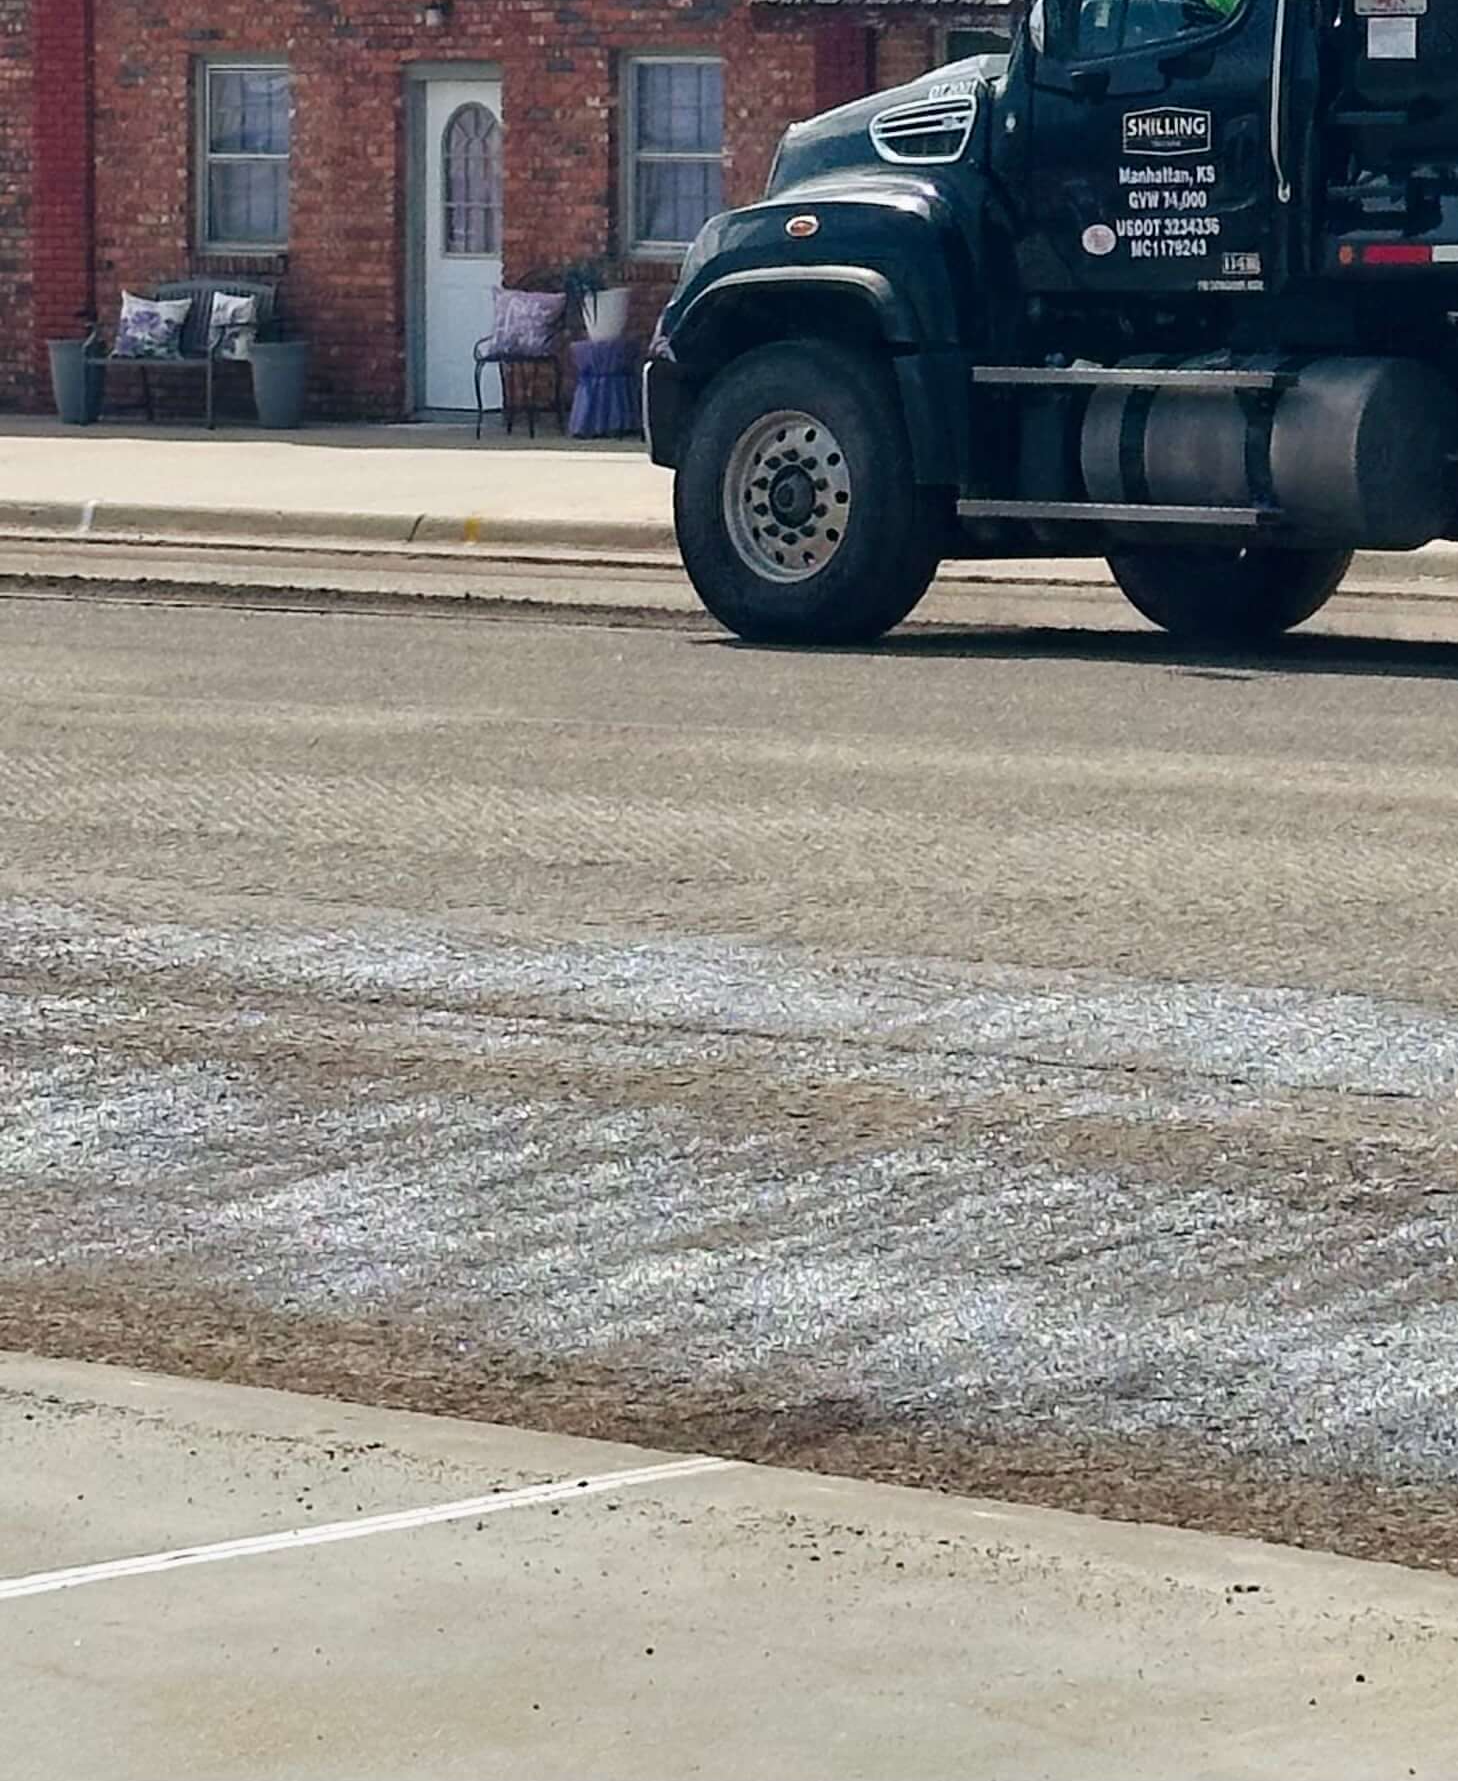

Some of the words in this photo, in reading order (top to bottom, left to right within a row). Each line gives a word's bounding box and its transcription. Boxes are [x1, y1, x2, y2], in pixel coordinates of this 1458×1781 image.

[1127, 117, 1206, 136] SHILLING
[1119, 166, 1193, 187] Manhattan,
[1196, 165, 1215, 183] KS
[1129, 191, 1159, 208] GVW
[1162, 190, 1207, 210] 74,000
[1116, 218, 1161, 237] USDOT
